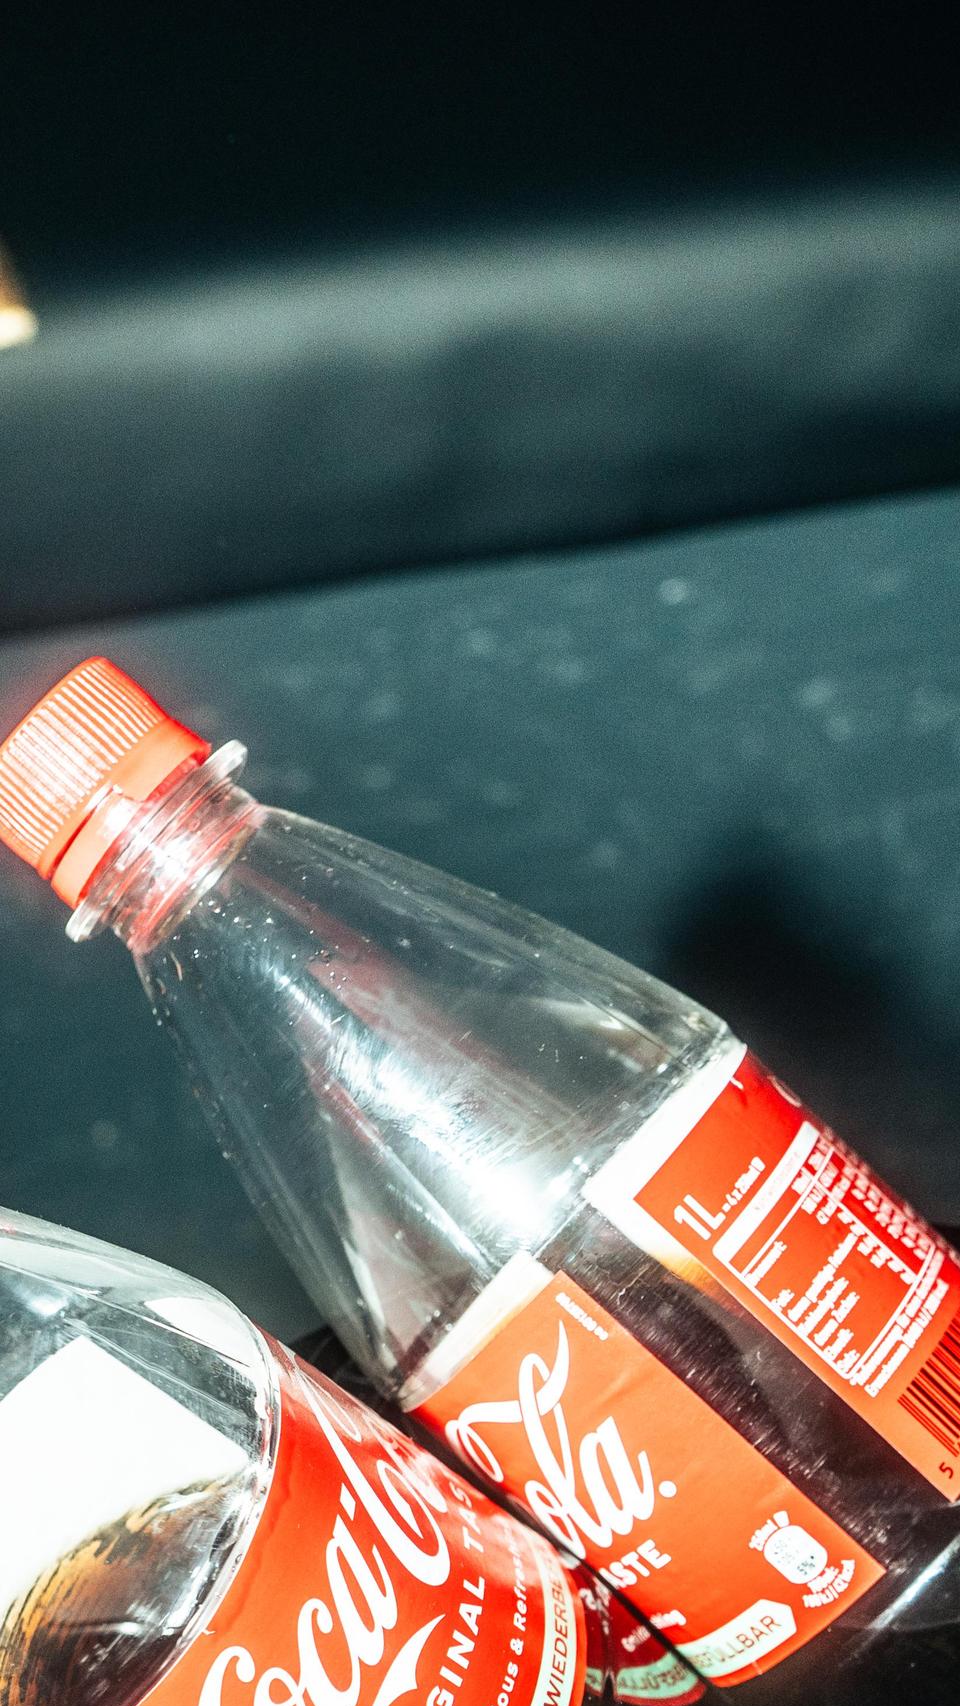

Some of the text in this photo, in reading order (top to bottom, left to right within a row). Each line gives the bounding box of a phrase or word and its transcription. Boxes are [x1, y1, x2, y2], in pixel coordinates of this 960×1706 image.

[674, 1194, 726, 1241] 1L
[938, 1461, 954, 1479] 5
[449, 1480, 484, 1553] TAS
[509, 1637, 524, 1656] &
